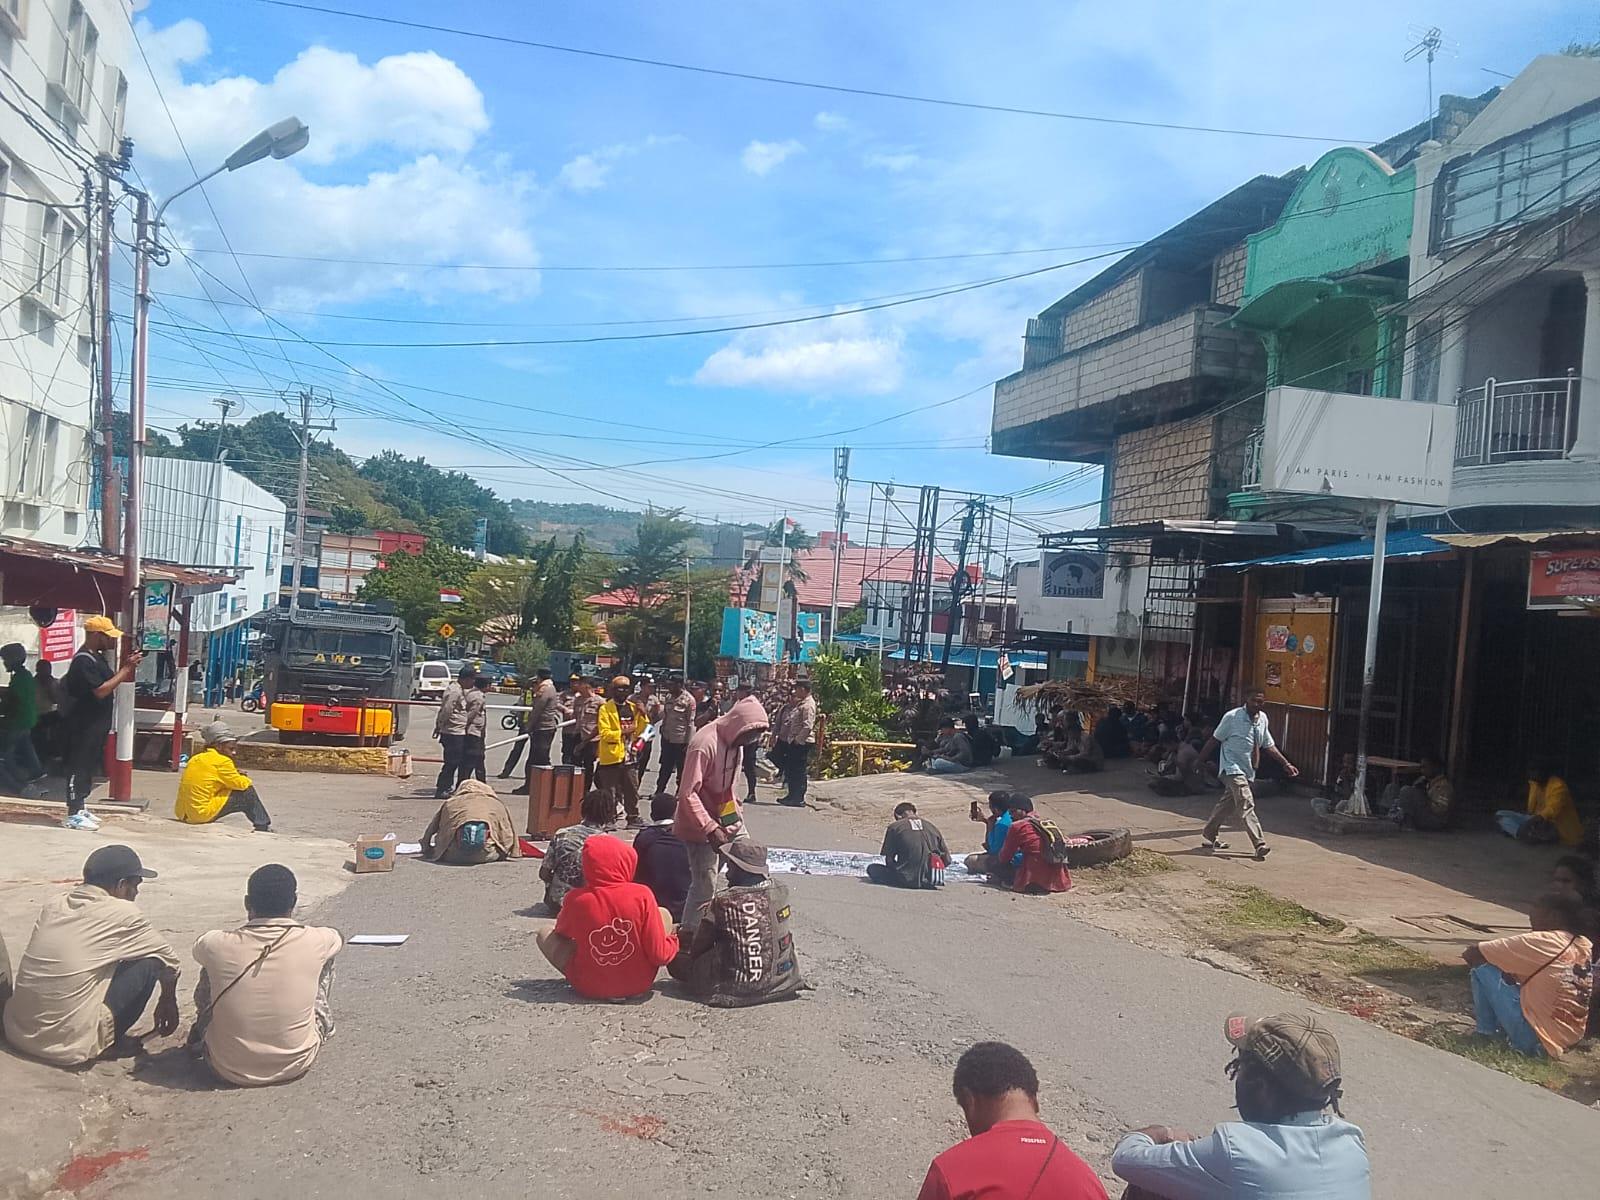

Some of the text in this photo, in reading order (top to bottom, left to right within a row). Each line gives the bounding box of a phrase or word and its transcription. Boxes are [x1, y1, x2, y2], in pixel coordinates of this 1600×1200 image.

[1295, 467, 1310, 475] AM
[1317, 468, 1348, 478] PARIS
[1398, 475, 1443, 487] FASHION
[743, 902, 763, 982] DANGER
